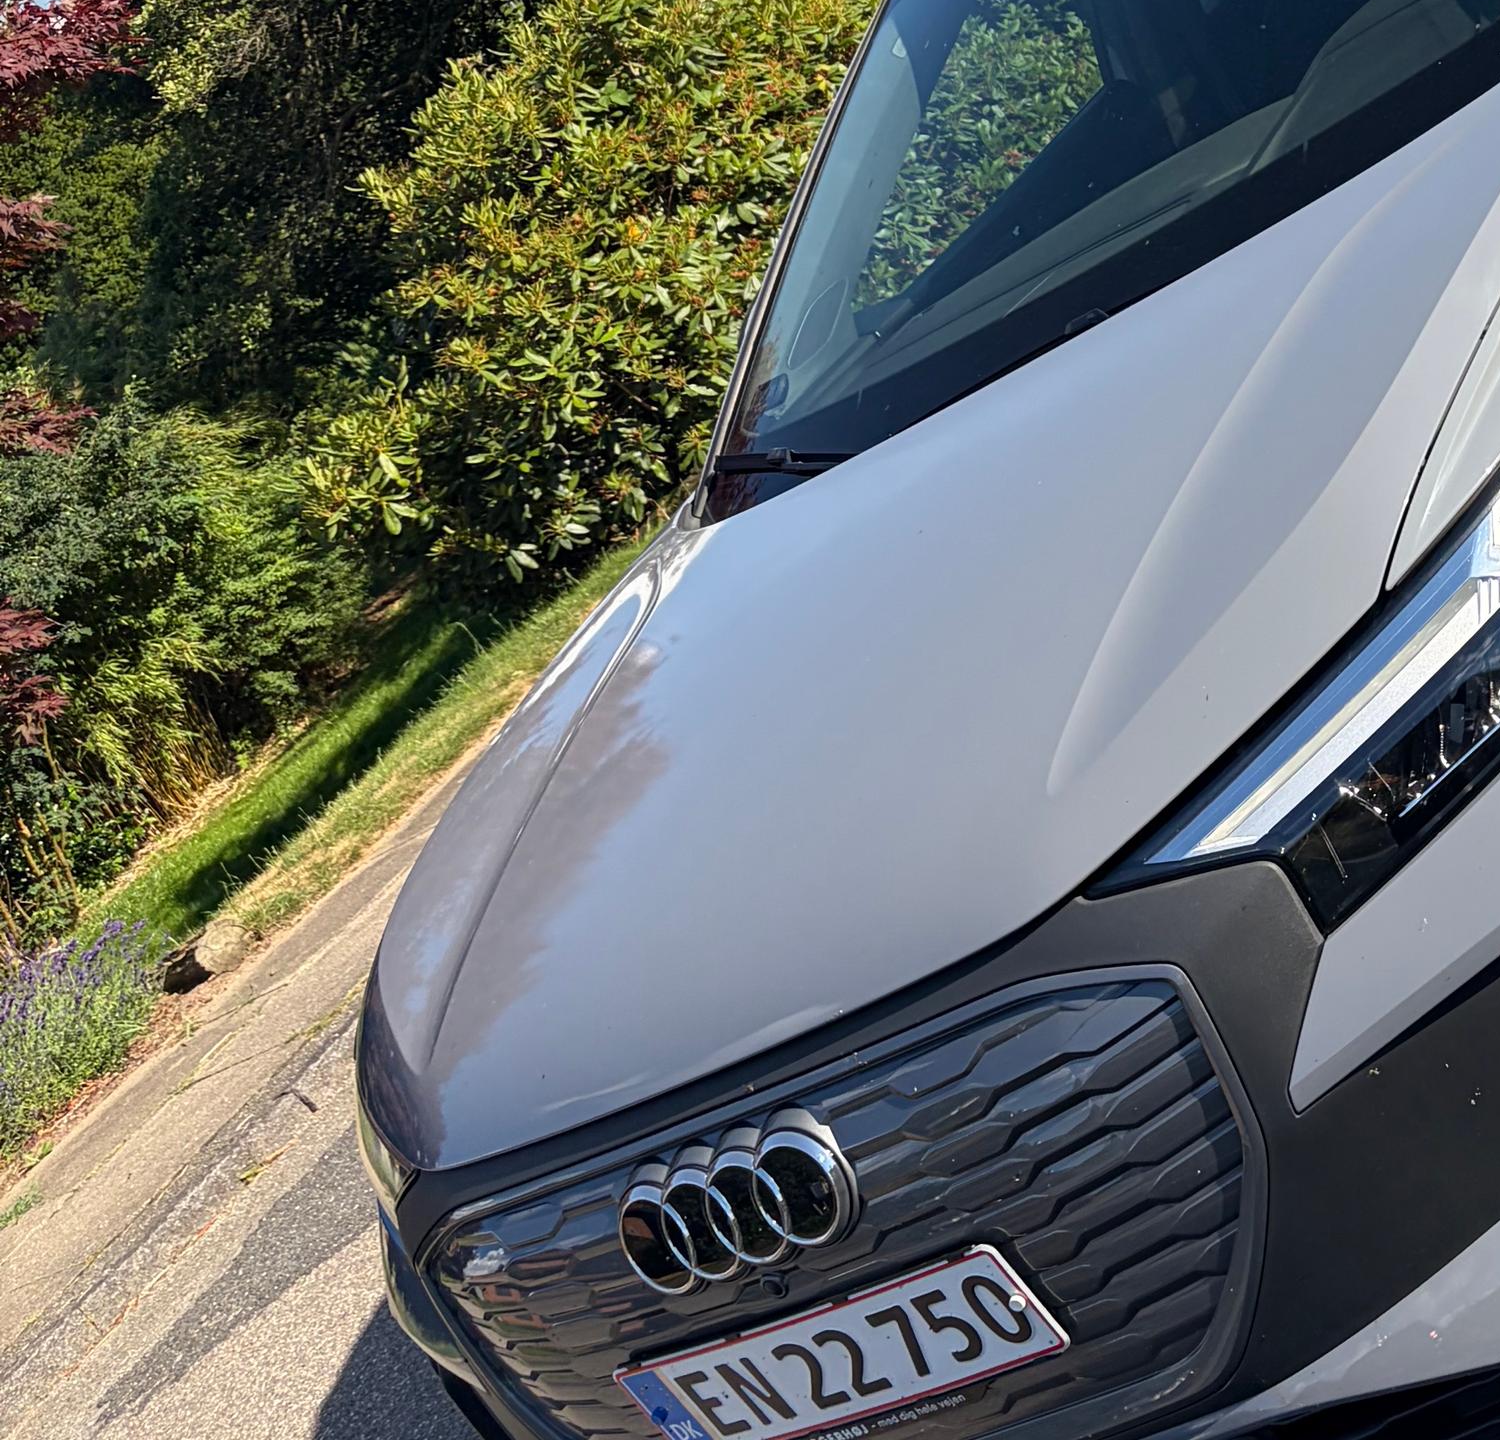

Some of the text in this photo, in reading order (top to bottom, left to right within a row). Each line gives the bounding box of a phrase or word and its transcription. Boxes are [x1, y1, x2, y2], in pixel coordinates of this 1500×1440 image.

[673, 1275, 1033, 1437] EN 22 750
[877, 1414, 900, 1428] med
[899, 1408, 918, 1423] dig
[914, 1403, 939, 1417] hele
[939, 1394, 967, 1410] vejen
[669, 1419, 704, 1440] DK
